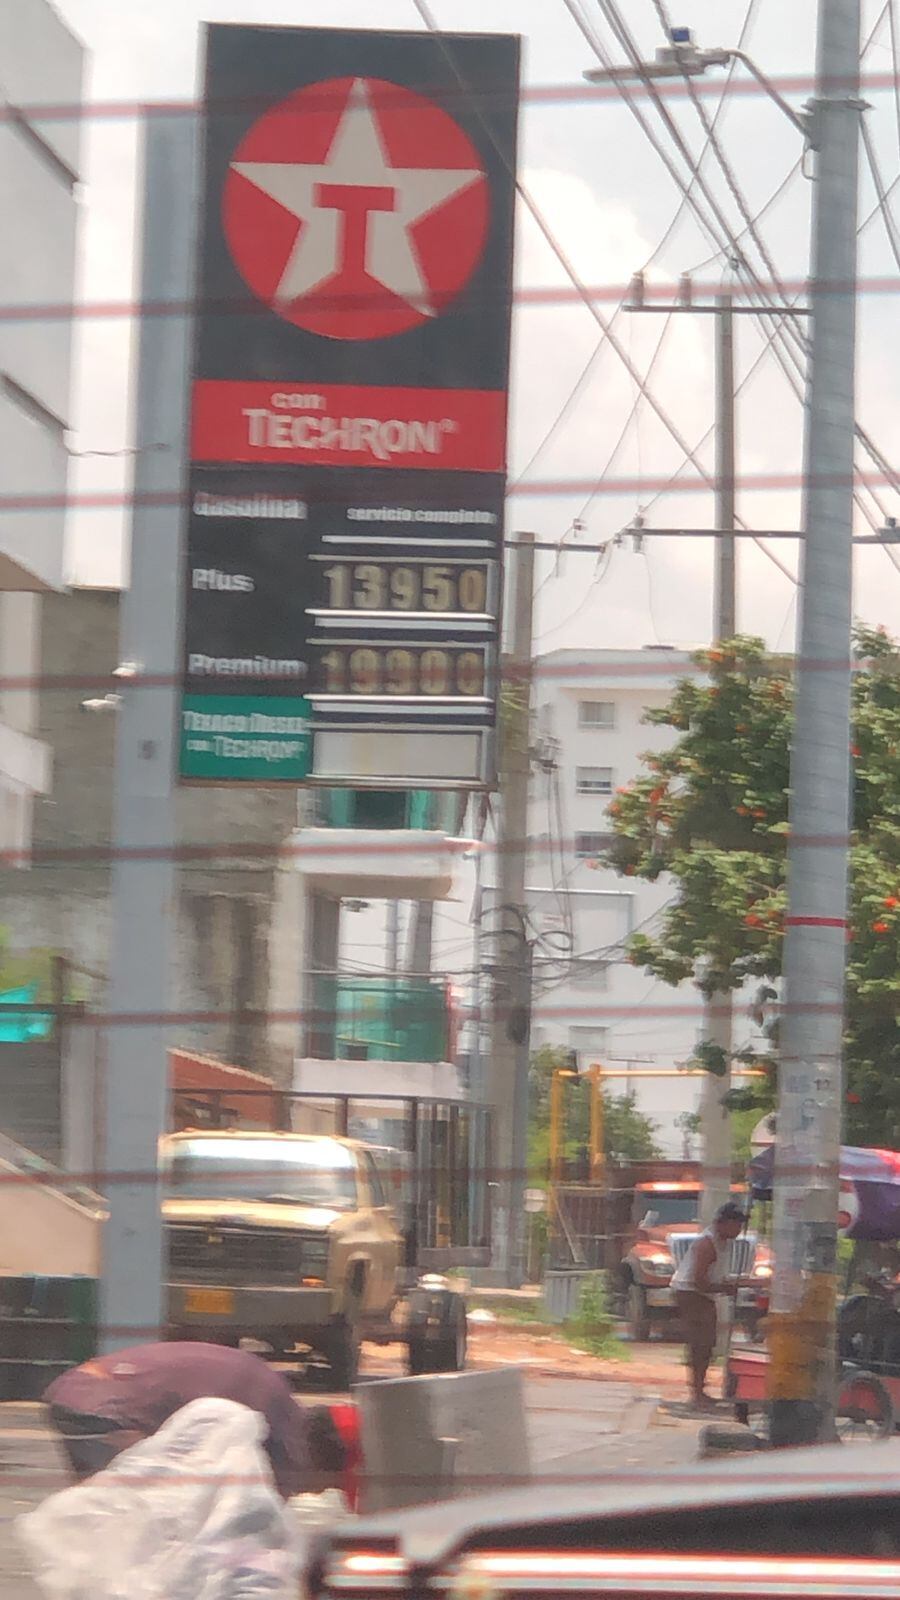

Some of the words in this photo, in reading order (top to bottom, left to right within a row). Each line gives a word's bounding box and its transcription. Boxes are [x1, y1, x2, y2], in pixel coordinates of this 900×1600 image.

[271, 393, 326, 410] con
[194, 492, 307, 519] Gasolina
[347, 506, 412, 521] servicio
[415, 509, 497, 524] completo
[192, 569, 255, 592] Plus
[323, 565, 486, 611] 13950
[188, 653, 308, 678] Premium
